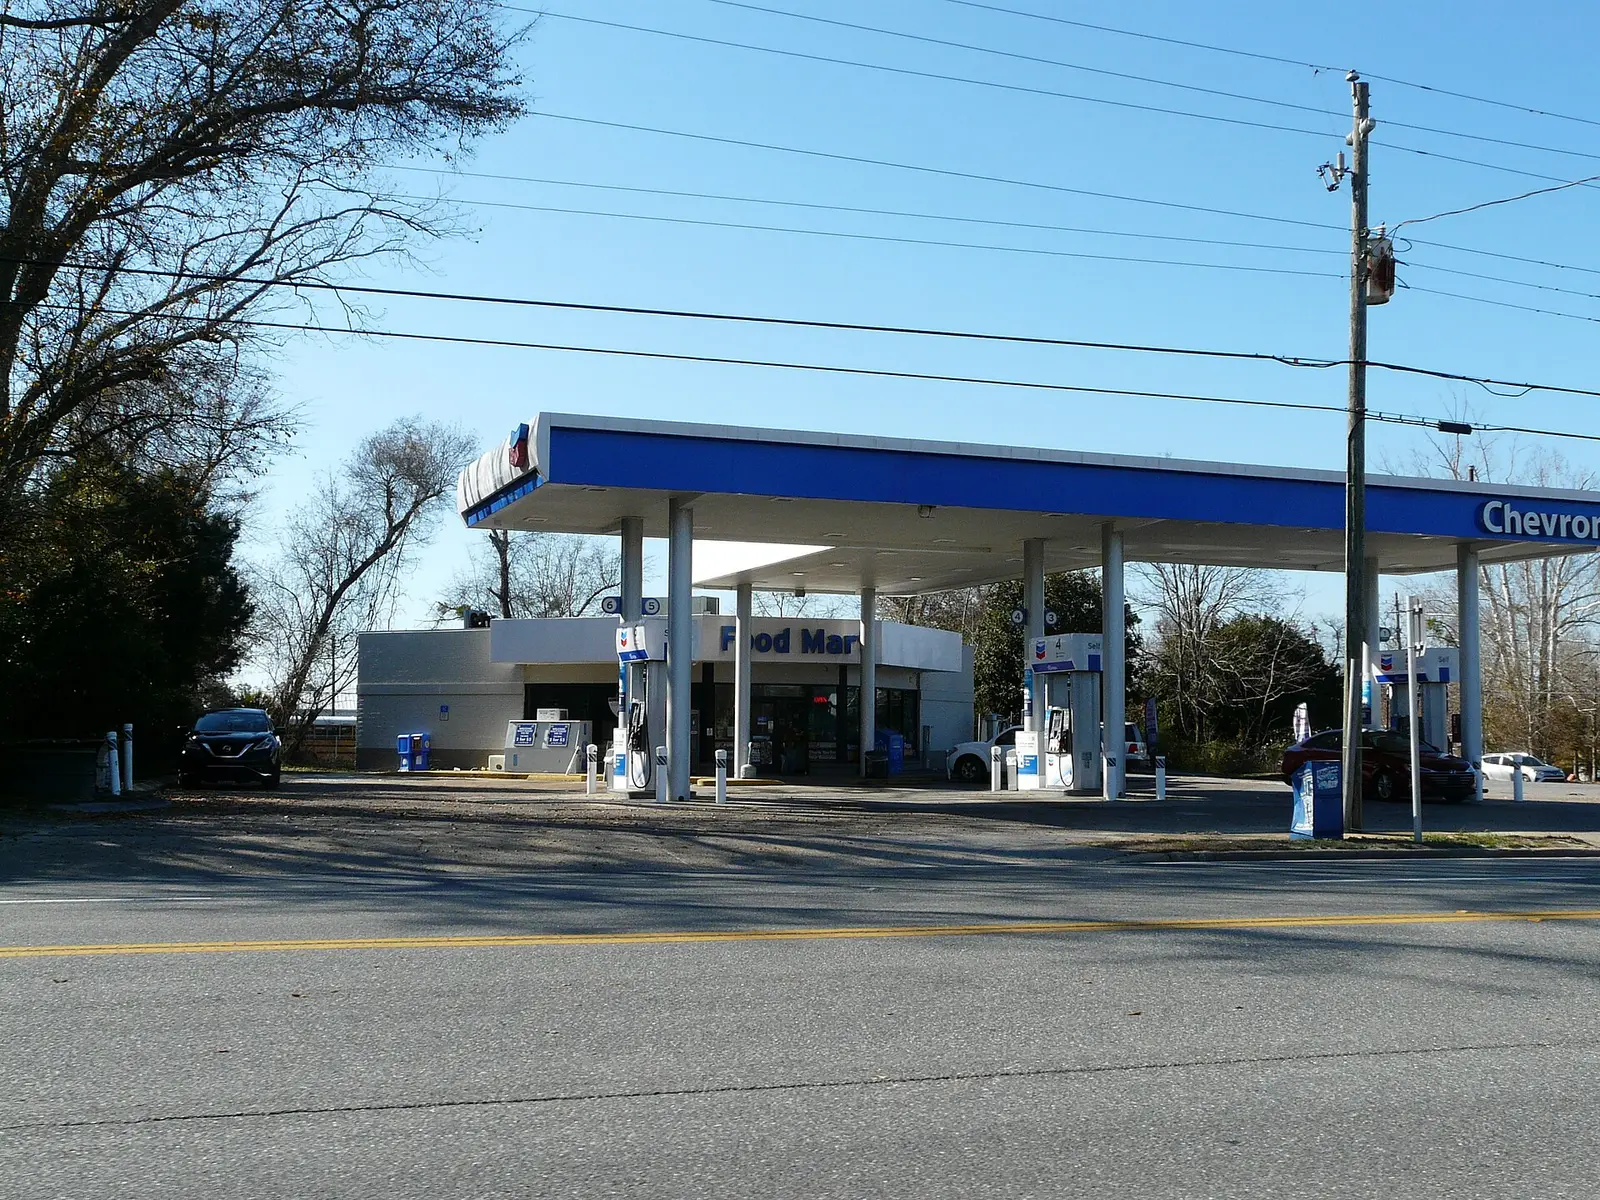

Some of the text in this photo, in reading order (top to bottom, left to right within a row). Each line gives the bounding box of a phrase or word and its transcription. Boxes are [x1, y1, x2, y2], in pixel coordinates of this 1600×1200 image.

[606, 600, 613, 609] 6
[648, 601, 655, 610] 5
[1014, 612, 1021, 621] 4
[1048, 613, 1054, 621] 3
[720, 625, 860, 654] Fod Mar
[1055, 638, 1061, 650] 4
